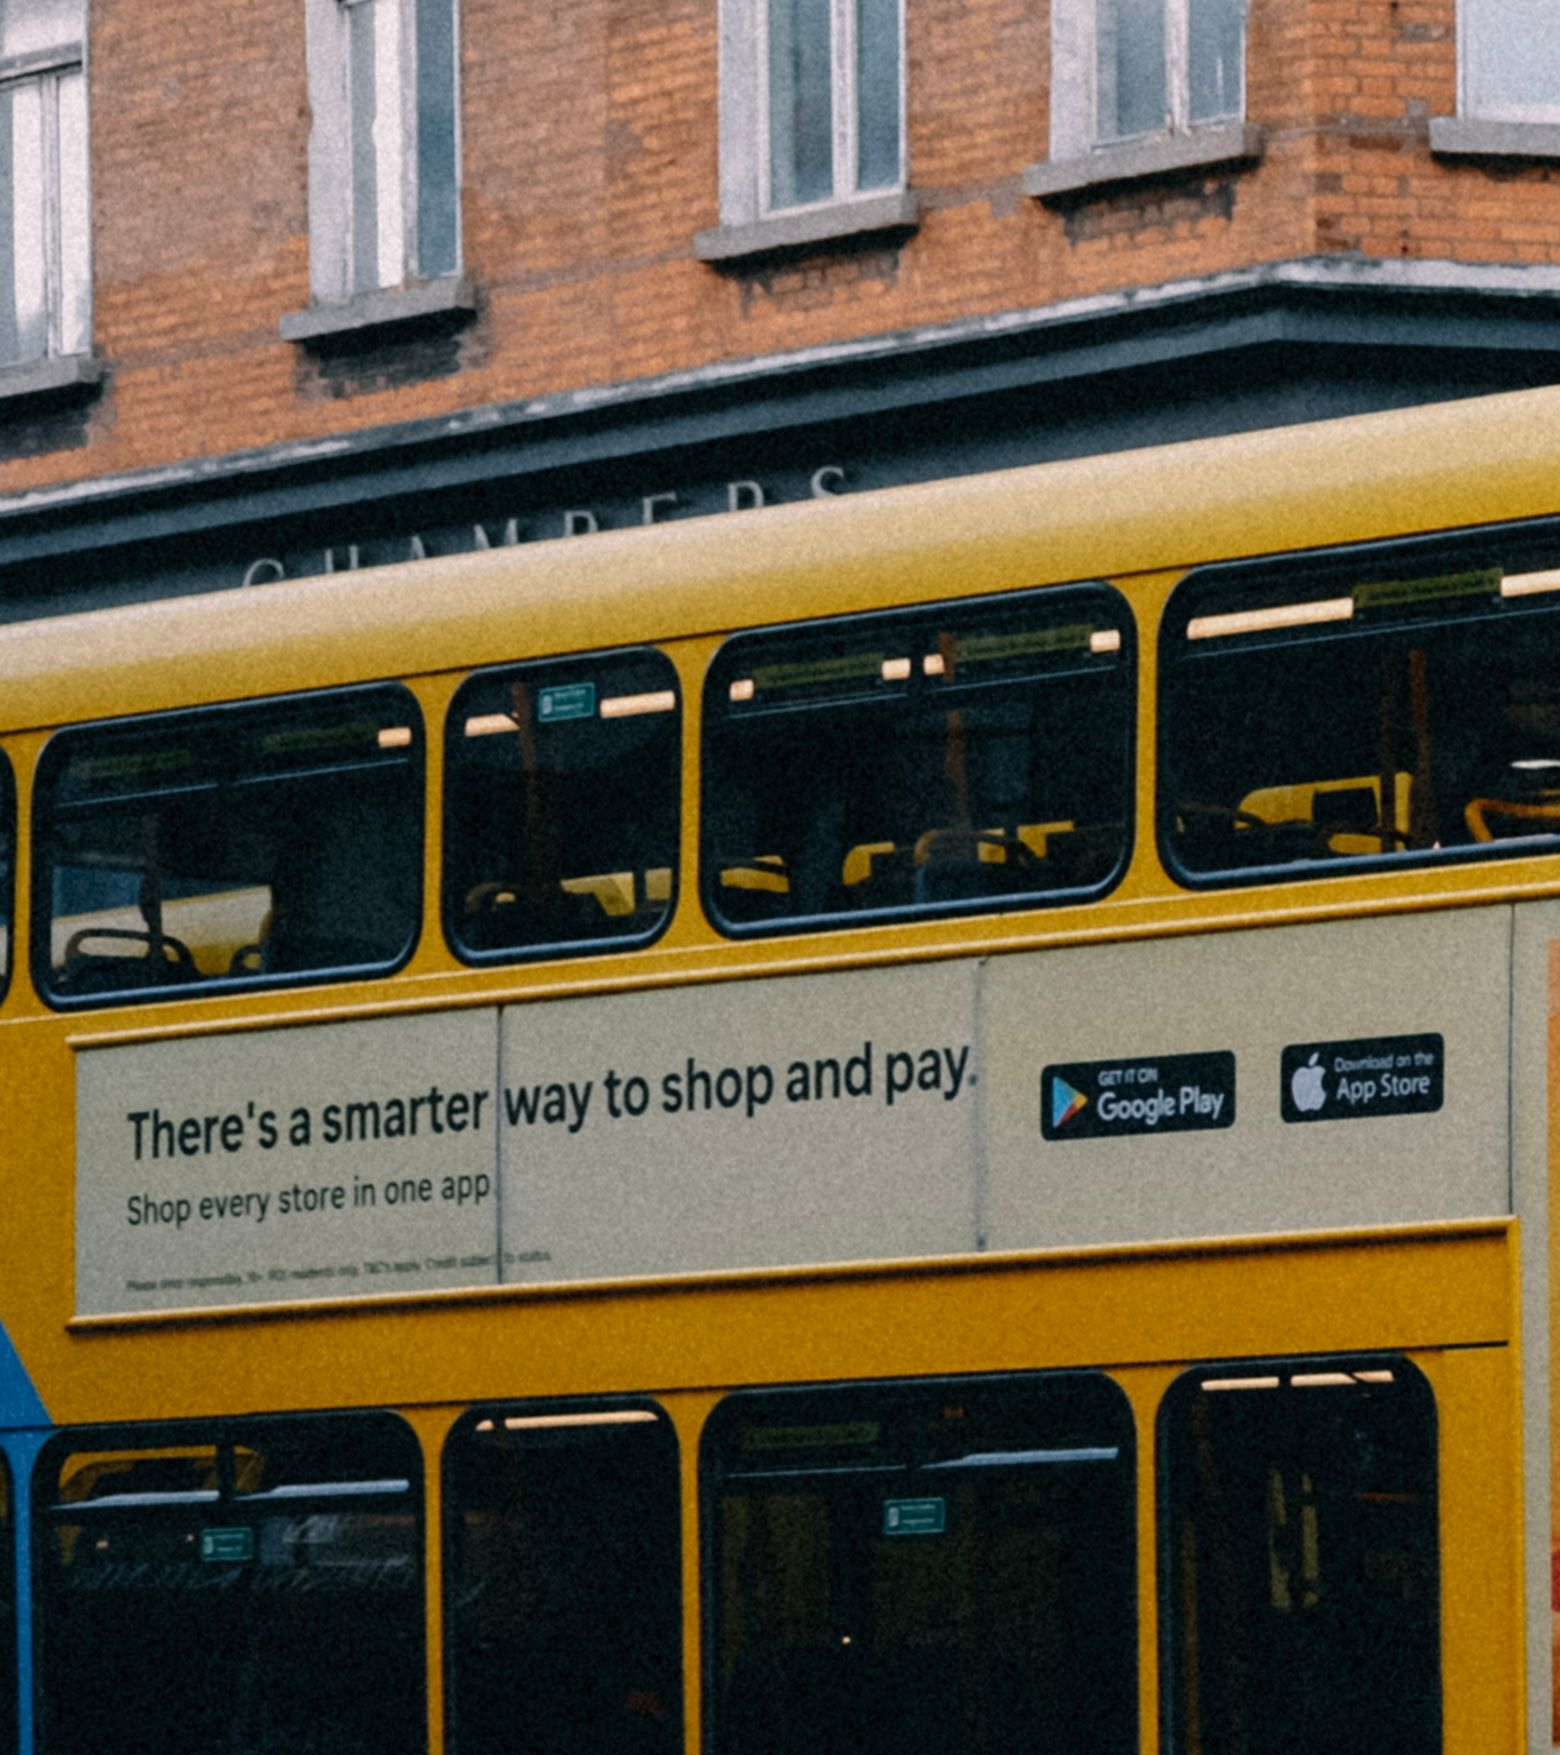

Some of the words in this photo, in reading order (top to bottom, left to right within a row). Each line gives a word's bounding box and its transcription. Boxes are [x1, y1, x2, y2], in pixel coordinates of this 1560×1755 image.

[1098, 1068, 1123, 1087] GET
[1125, 1068, 1136, 1086] IT
[1138, 1066, 1158, 1084] ON
[1334, 1054, 1393, 1074] Download
[1396, 1055, 1412, 1069] on
[1414, 1050, 1434, 1068] the
[127, 1101, 277, 1161] There's
[288, 1105, 311, 1147] a
[322, 1086, 488, 1144] smarter
[505, 1079, 593, 1133] way
[604, 1070, 650, 1118] to
[661, 1055, 775, 1117] shop
[786, 1041, 873, 1102] and
[885, 1045, 979, 1098] pay.
[1098, 1089, 1176, 1126] Google
[1179, 1085, 1224, 1120] Play
[1336, 1077, 1376, 1105] App
[1380, 1072, 1430, 1097] Store
[127, 1195, 191, 1228] Shop
[199, 1190, 270, 1222] every
[277, 1182, 346, 1213] store
[353, 1177, 376, 1208] in
[383, 1180, 431, 1205] one
[440, 1172, 490, 1205] app
